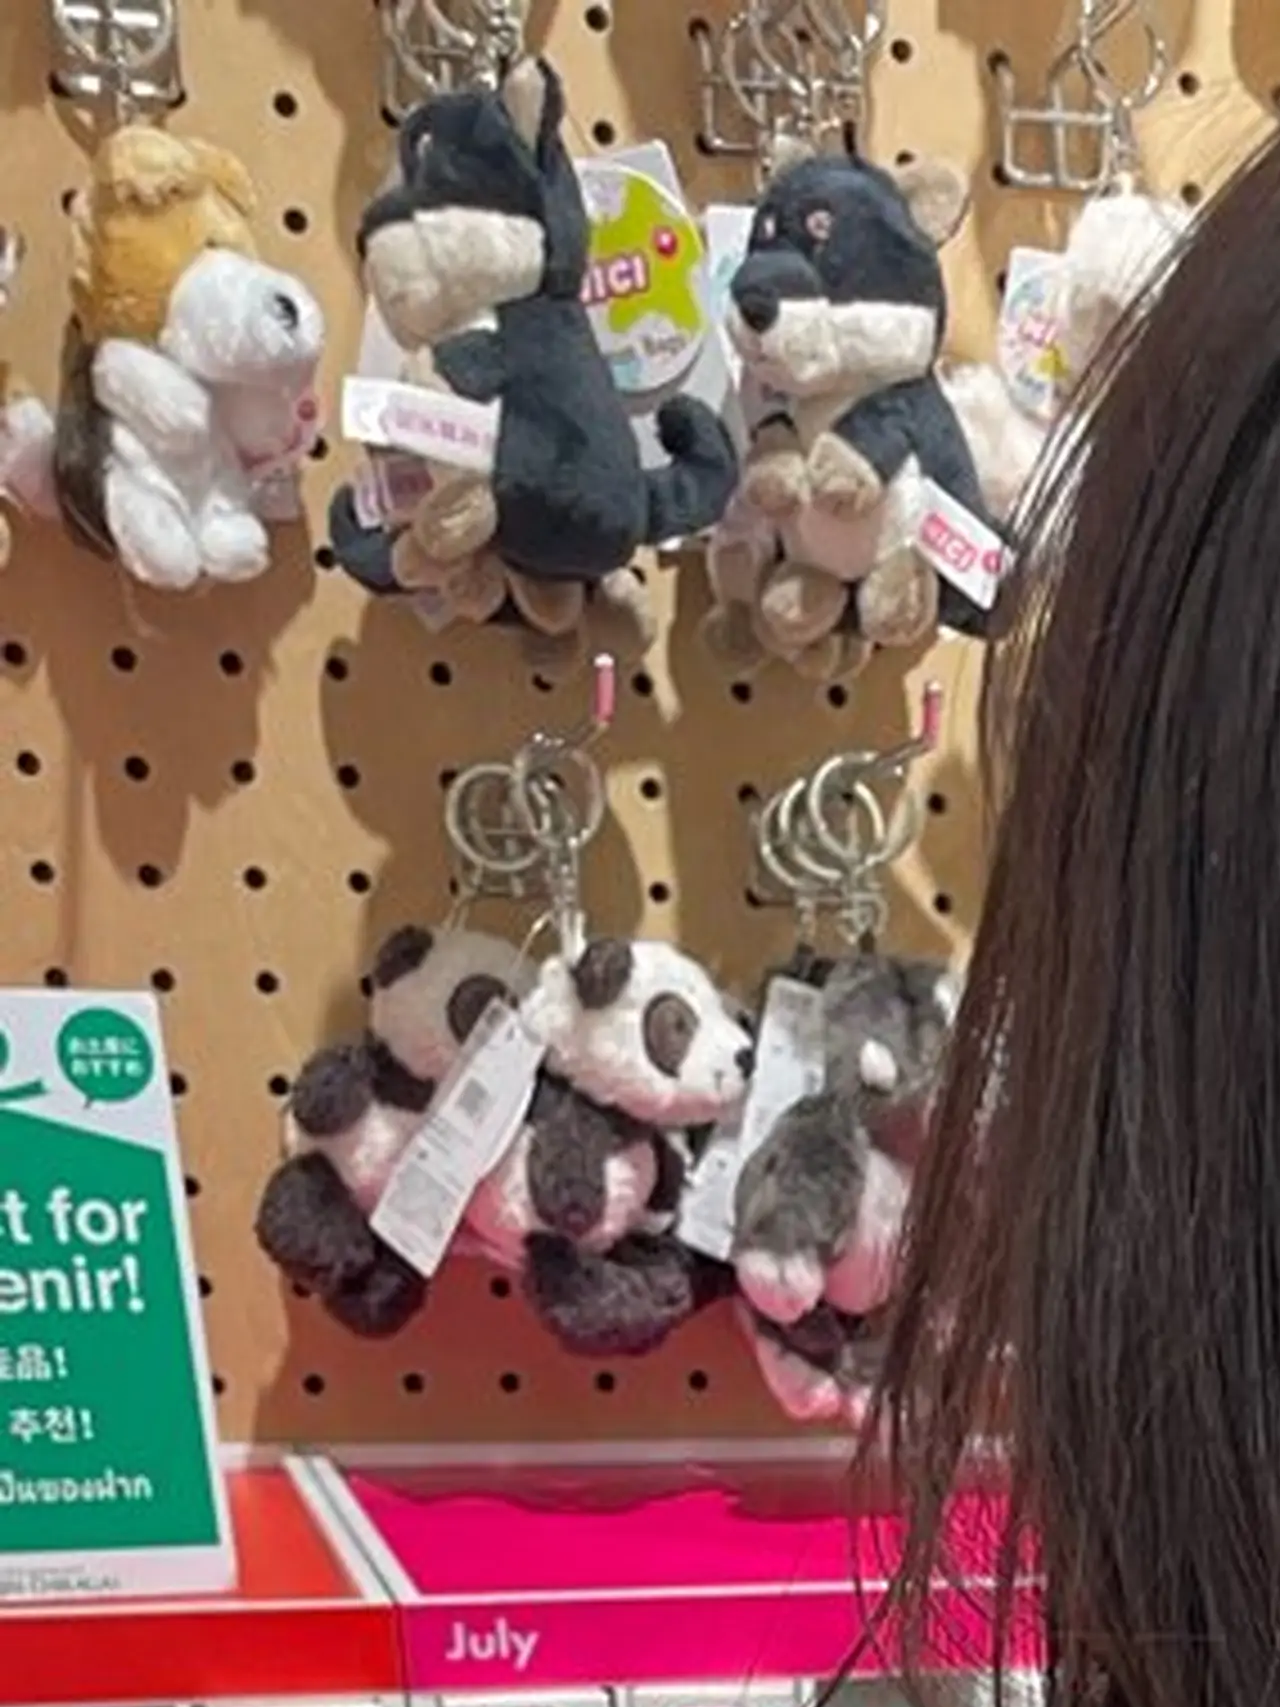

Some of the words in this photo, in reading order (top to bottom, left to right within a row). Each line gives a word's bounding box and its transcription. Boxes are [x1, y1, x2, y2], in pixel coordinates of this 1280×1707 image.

[0, 1190, 33, 1245] t
[46, 1186, 148, 1245] for
[0, 1254, 146, 1314] enir!
[445, 1619, 540, 1671] July
